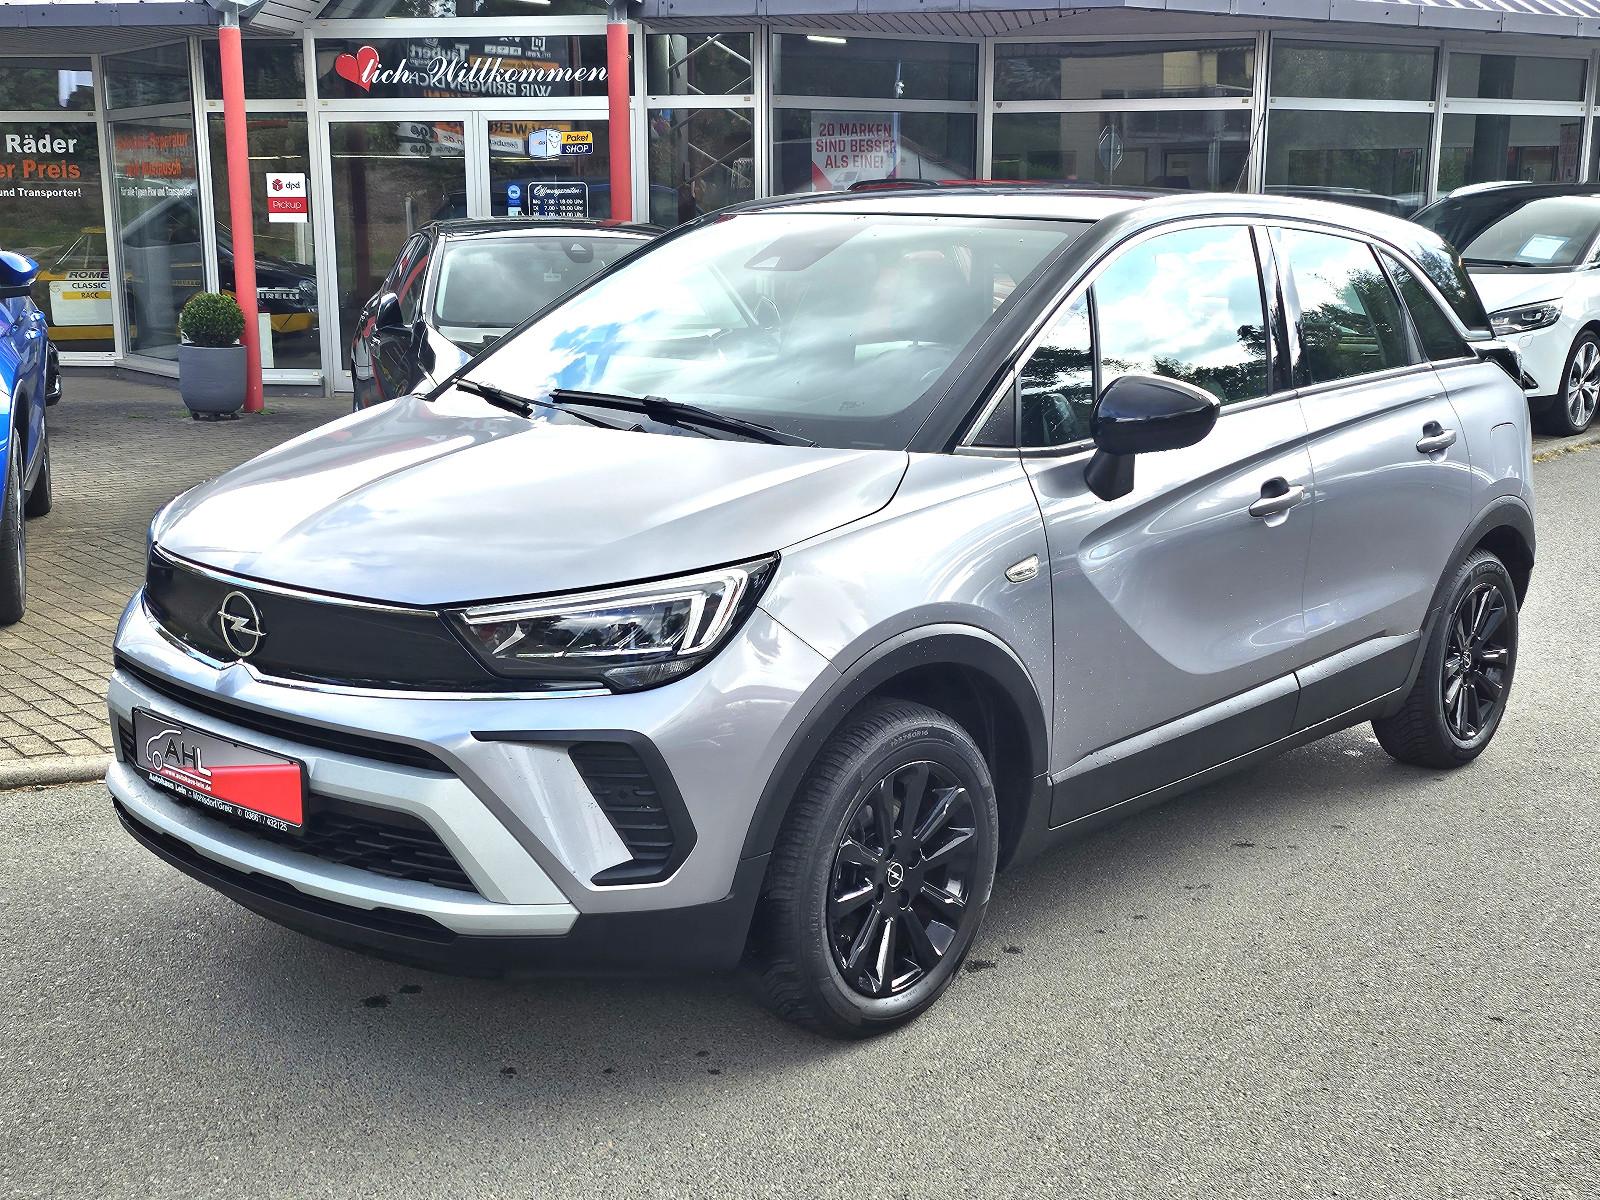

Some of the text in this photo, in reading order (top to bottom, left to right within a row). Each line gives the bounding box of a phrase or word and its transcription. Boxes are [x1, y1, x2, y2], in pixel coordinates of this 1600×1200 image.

[361, 58, 412, 84] lich
[425, 56, 609, 83] Willkommen
[820, 123, 891, 137] 20 MARKEN
[5, 134, 78, 153] Räder
[566, 133, 589, 142] Paket
[565, 145, 589, 153] SHOP
[816, 139, 897, 153] SIND BESSER
[0, 159, 81, 179] er Preis
[825, 155, 884, 169] ALS EINE!
[285, 181, 301, 190] dpd
[17, 187, 82, 199] Transporter!
[272, 200, 302, 210] Pickup
[164, 737, 212, 777] AHL
[148, 772, 175, 790] Autohaus
[175, 783, 187, 796] Lein
[267, 817, 288, 832] 432125
